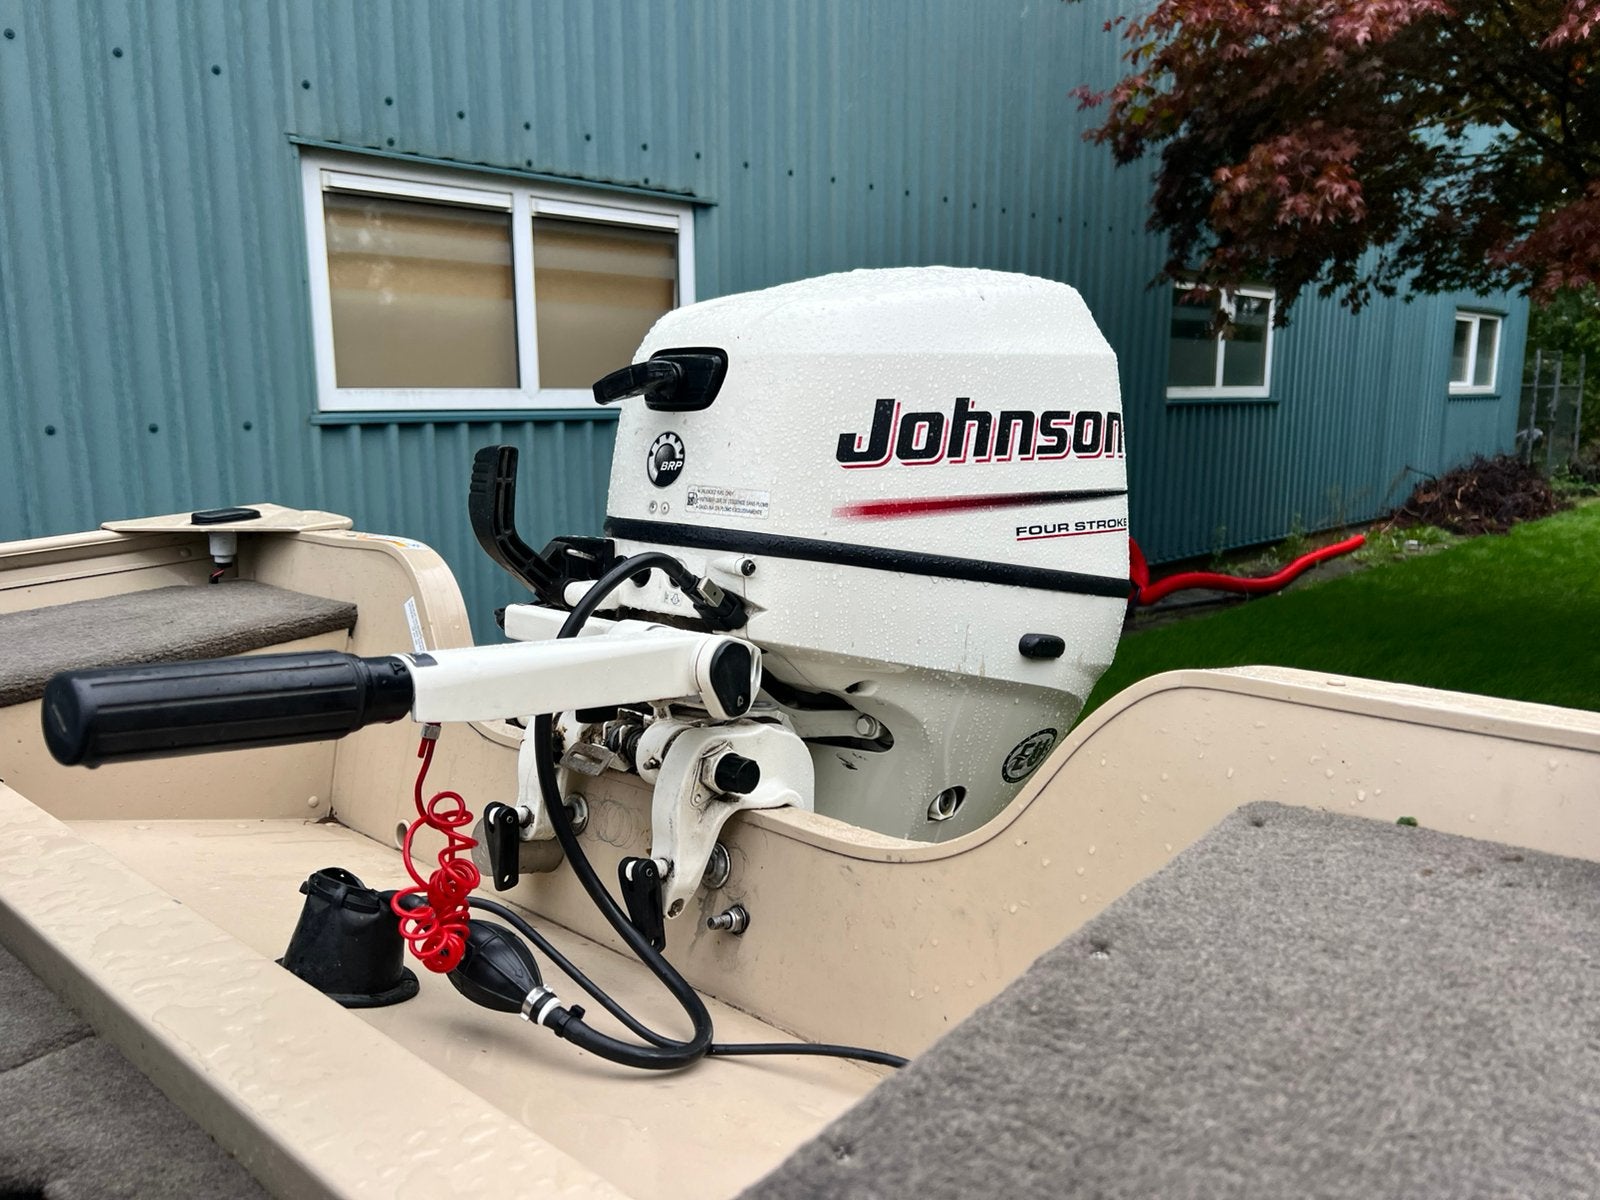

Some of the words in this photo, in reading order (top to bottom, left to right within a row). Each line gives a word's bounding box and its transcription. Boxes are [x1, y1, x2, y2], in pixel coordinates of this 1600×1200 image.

[836, 397, 1125, 469] Johnson
[660, 461, 683, 471] BRP
[1016, 522, 1069, 537] FOUR
[1075, 517, 1127, 532] STROKE
